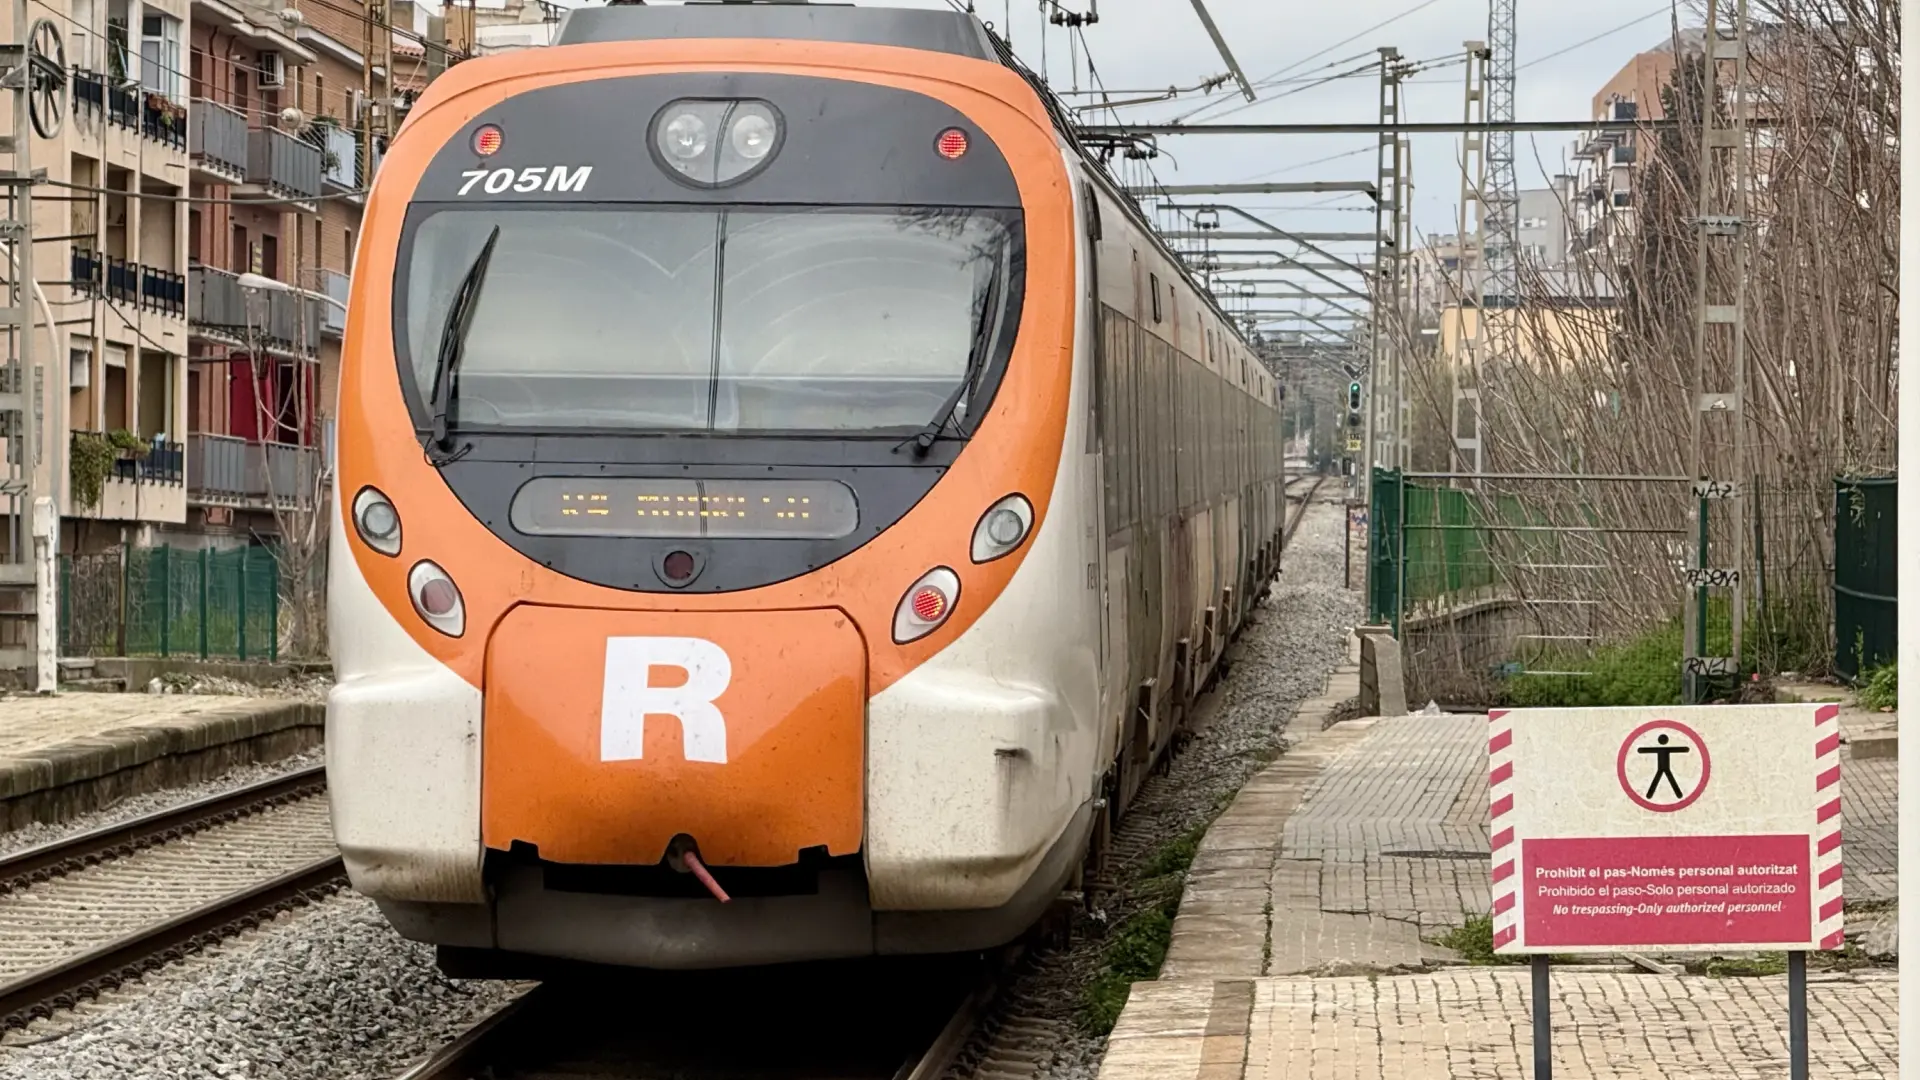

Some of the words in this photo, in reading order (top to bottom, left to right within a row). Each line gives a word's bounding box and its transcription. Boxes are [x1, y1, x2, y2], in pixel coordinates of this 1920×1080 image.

[457, 166, 593, 195] 705M
[601, 636, 732, 764] R
[1535, 867, 1586, 878] Prohibit
[1589, 867, 1600, 878] el
[1604, 866, 1675, 880] pas-Només
[1679, 865, 1734, 879] personal
[1737, 864, 1798, 875] autoritzat
[1538, 885, 1595, 896] Prohibido
[1599, 885, 1609, 896] el
[1613, 884, 1674, 898] paso-Solo
[1677, 883, 1728, 897] personal
[1732, 883, 1796, 894] autorizado
[1553, 904, 1568, 914] No
[1572, 903, 1663, 916] trespassing-Only
[1666, 902, 1725, 913] authorized
[1727, 901, 1782, 915] personnel
